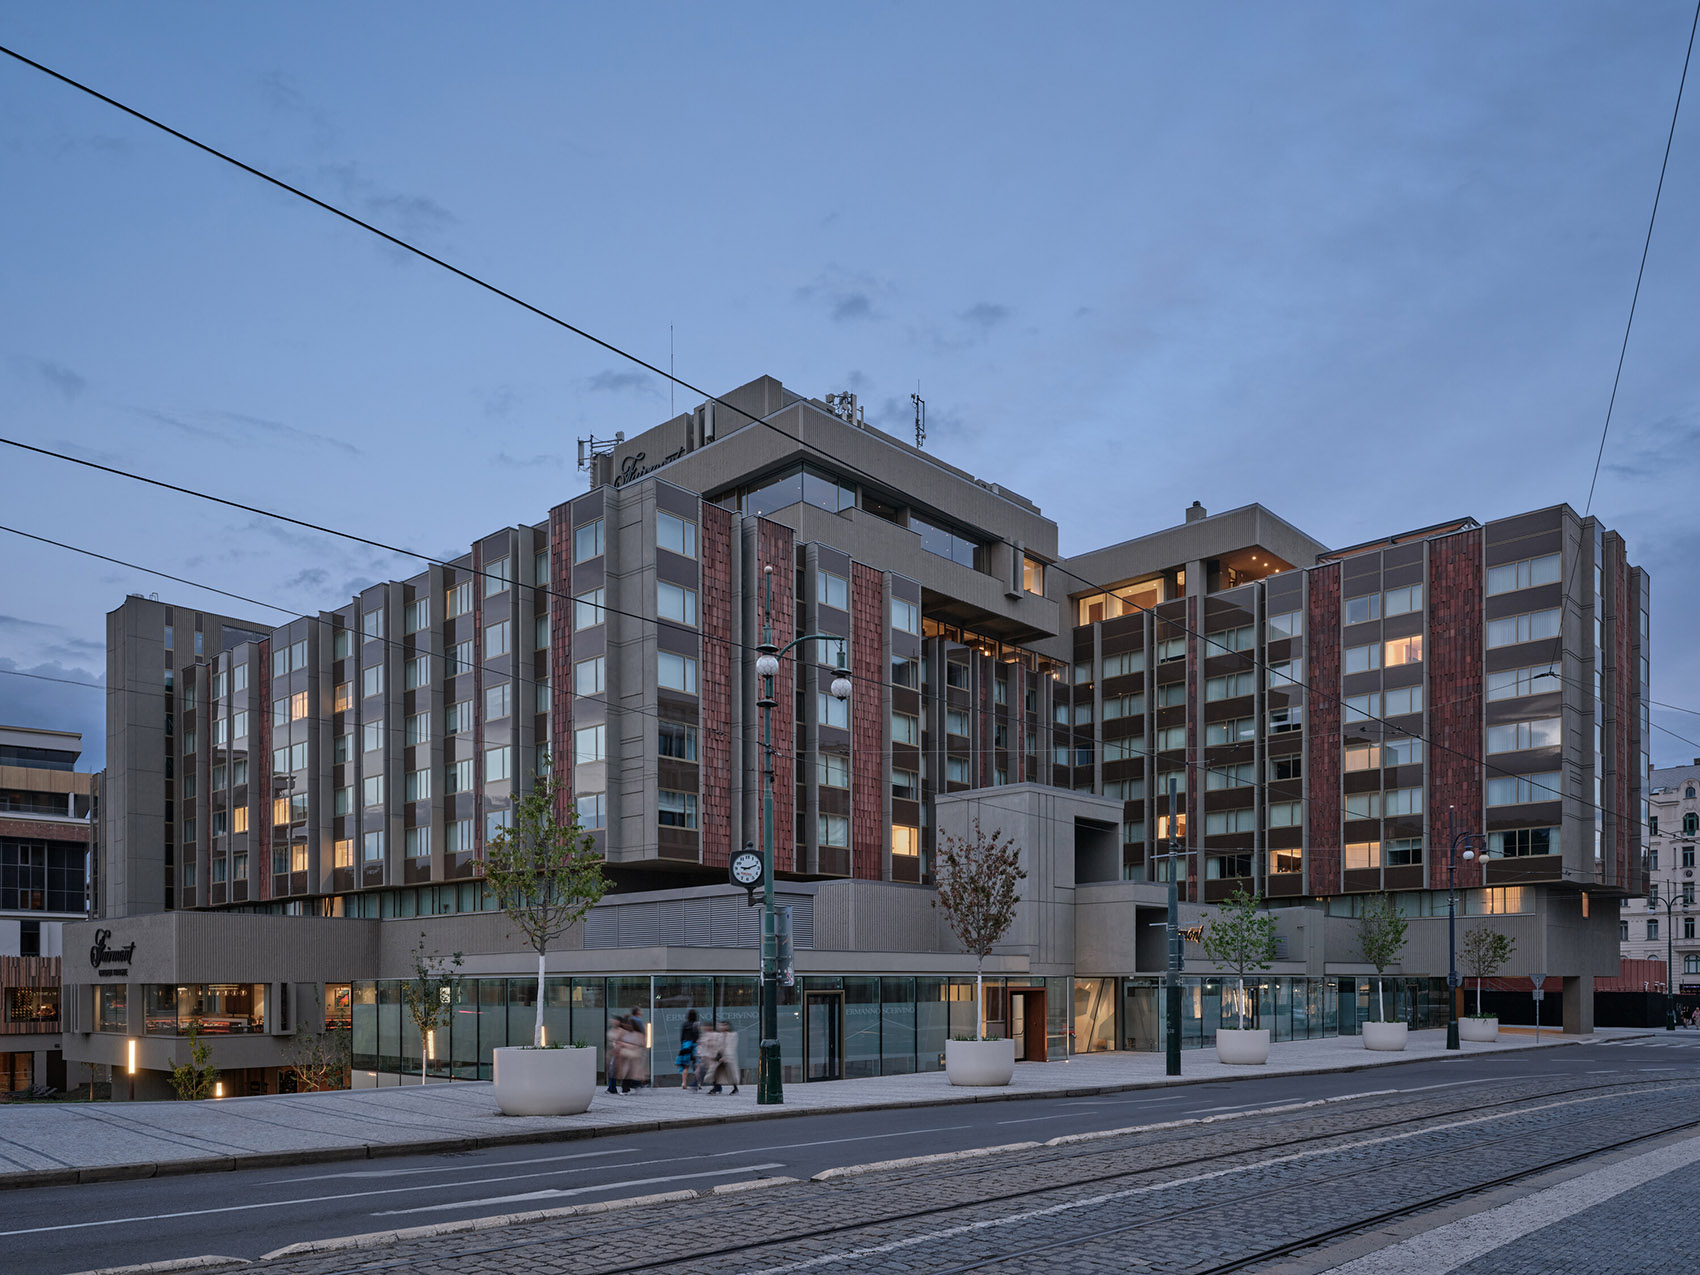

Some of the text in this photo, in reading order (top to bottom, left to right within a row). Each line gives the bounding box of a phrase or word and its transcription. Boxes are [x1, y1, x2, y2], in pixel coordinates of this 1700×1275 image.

[90, 928, 136, 968] Fairmont
[666, 1011, 758, 1021] ERMNO SCERVINO
